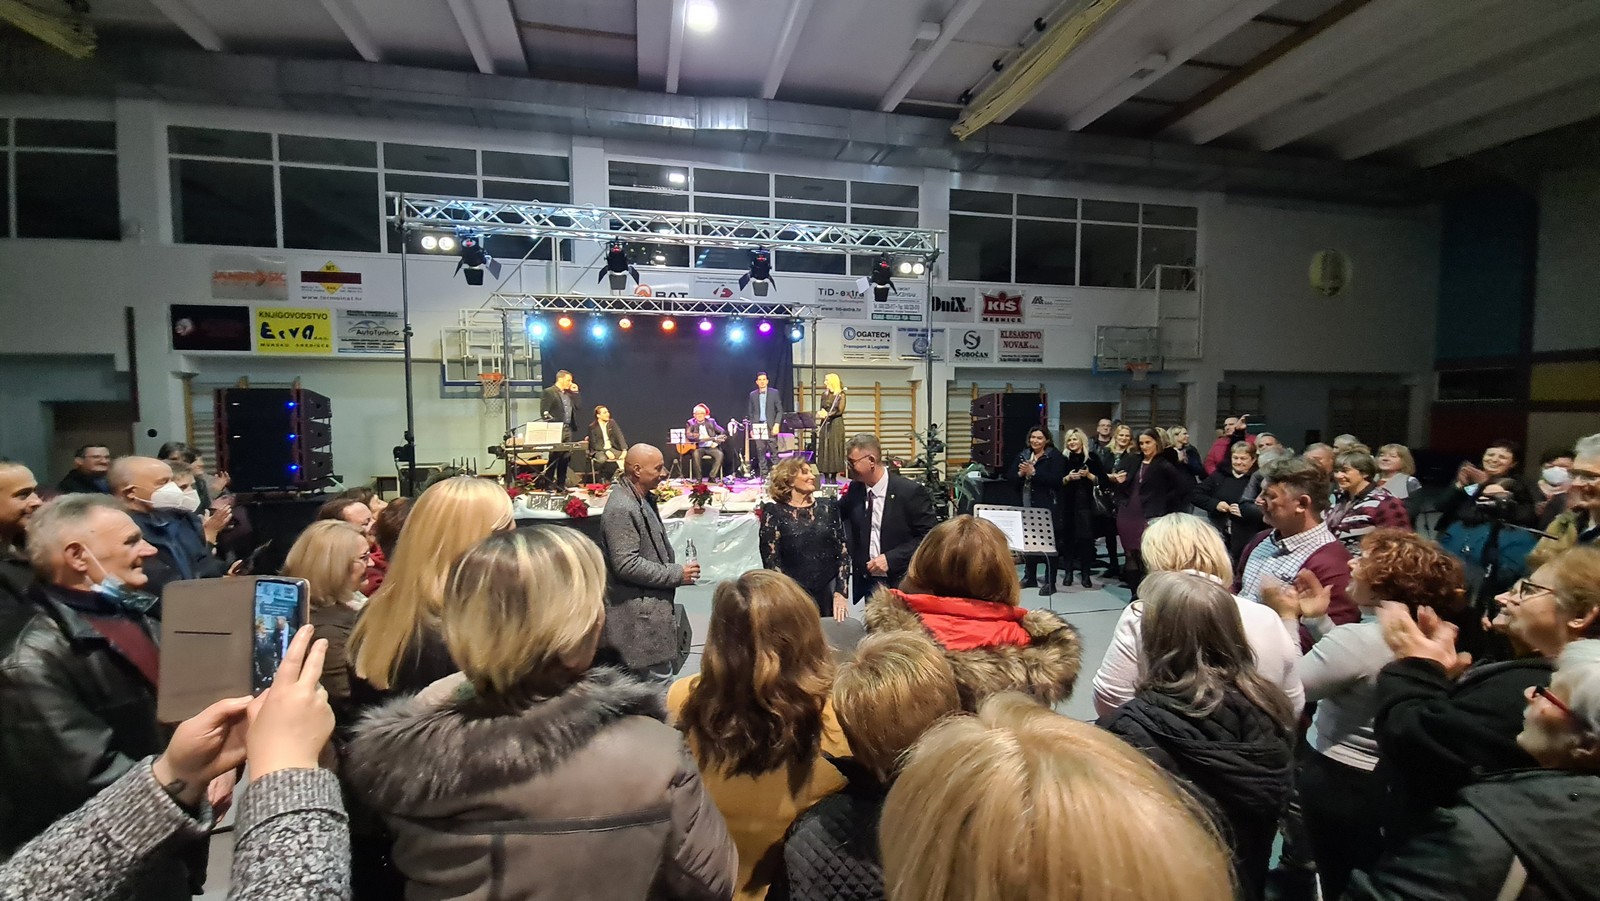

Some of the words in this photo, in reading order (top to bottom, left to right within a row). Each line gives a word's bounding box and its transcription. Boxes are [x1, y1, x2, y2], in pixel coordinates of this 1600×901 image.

[259, 311, 328, 320] KNJIGOVODSTVO
[1000, 330, 1042, 340] KLESARSTVO
[1003, 340, 1029, 349] NOVAK
